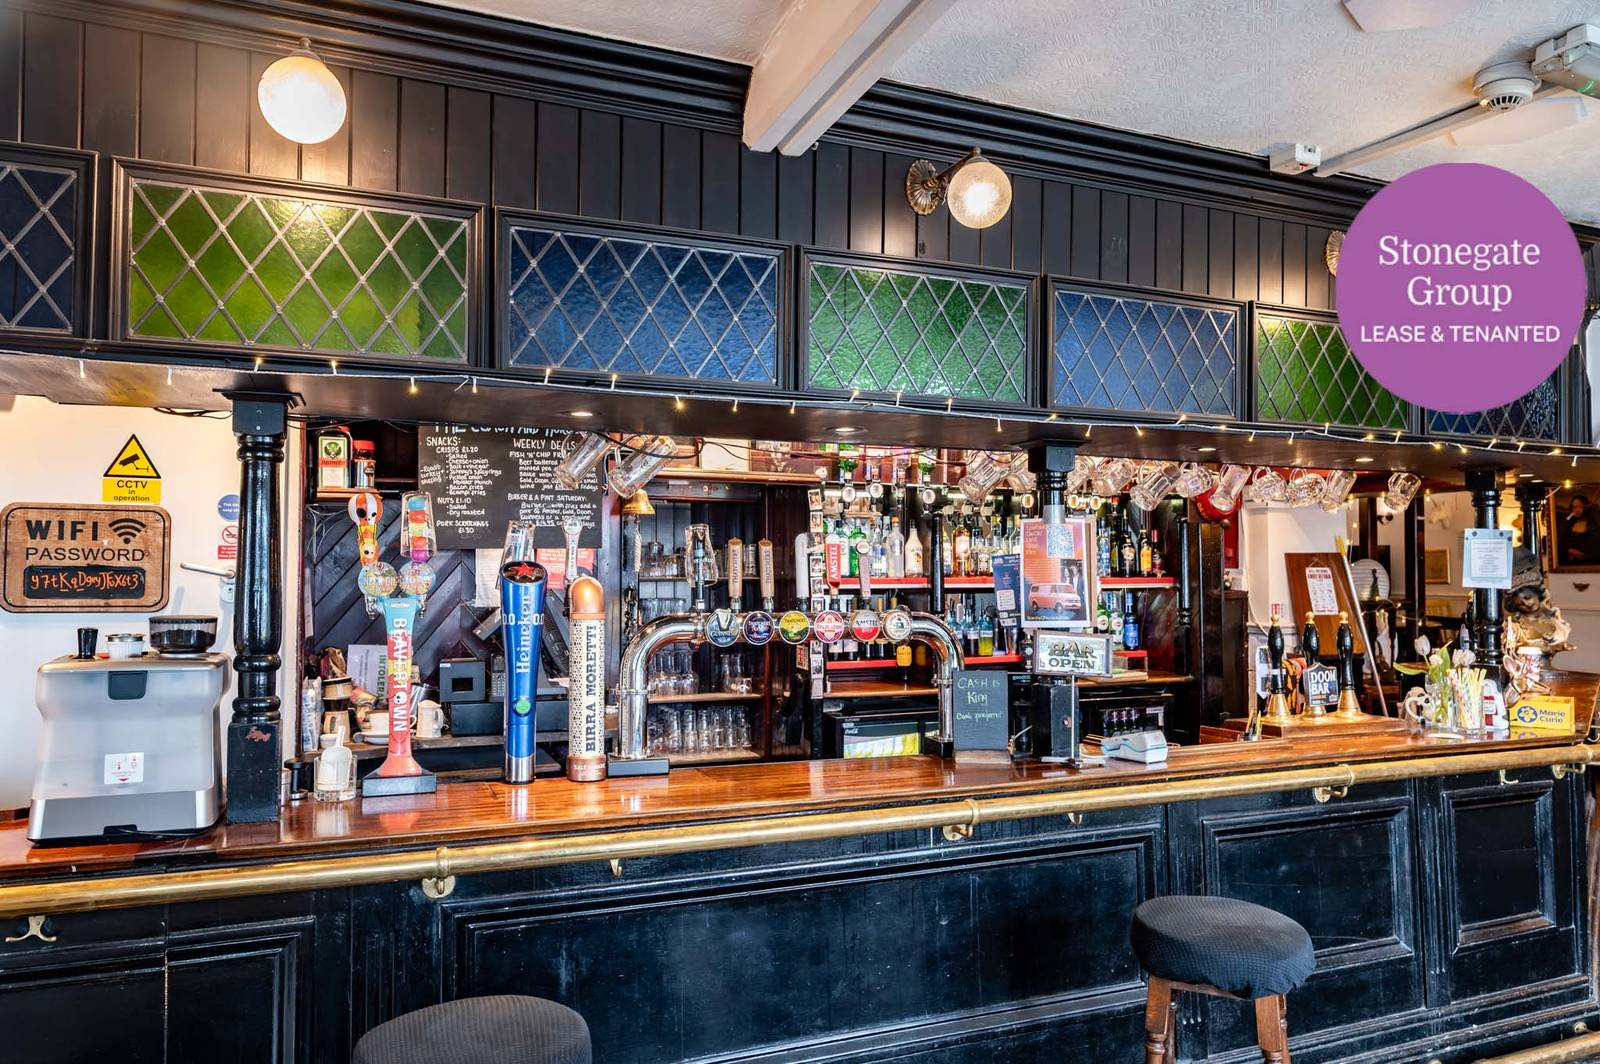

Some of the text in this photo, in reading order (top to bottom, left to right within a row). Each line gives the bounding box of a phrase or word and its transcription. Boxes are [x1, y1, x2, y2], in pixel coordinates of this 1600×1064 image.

[426, 436, 461, 446] SNACKS:
[513, 438, 546, 448] WEEKLY
[117, 480, 148, 489] CCTV
[26, 520, 98, 540] WIFI
[25, 548, 145, 561] PASSWORD
[516, 596, 532, 673] Heineken
[1048, 640, 1096, 658] BAR
[1048, 658, 1094, 669] OPEN
[1310, 670, 1336, 683] DOOM
[586, 626, 597, 752] BIRRA MORETTI
[1312, 682, 1330, 695] BAR
[967, 691, 988, 706] King
